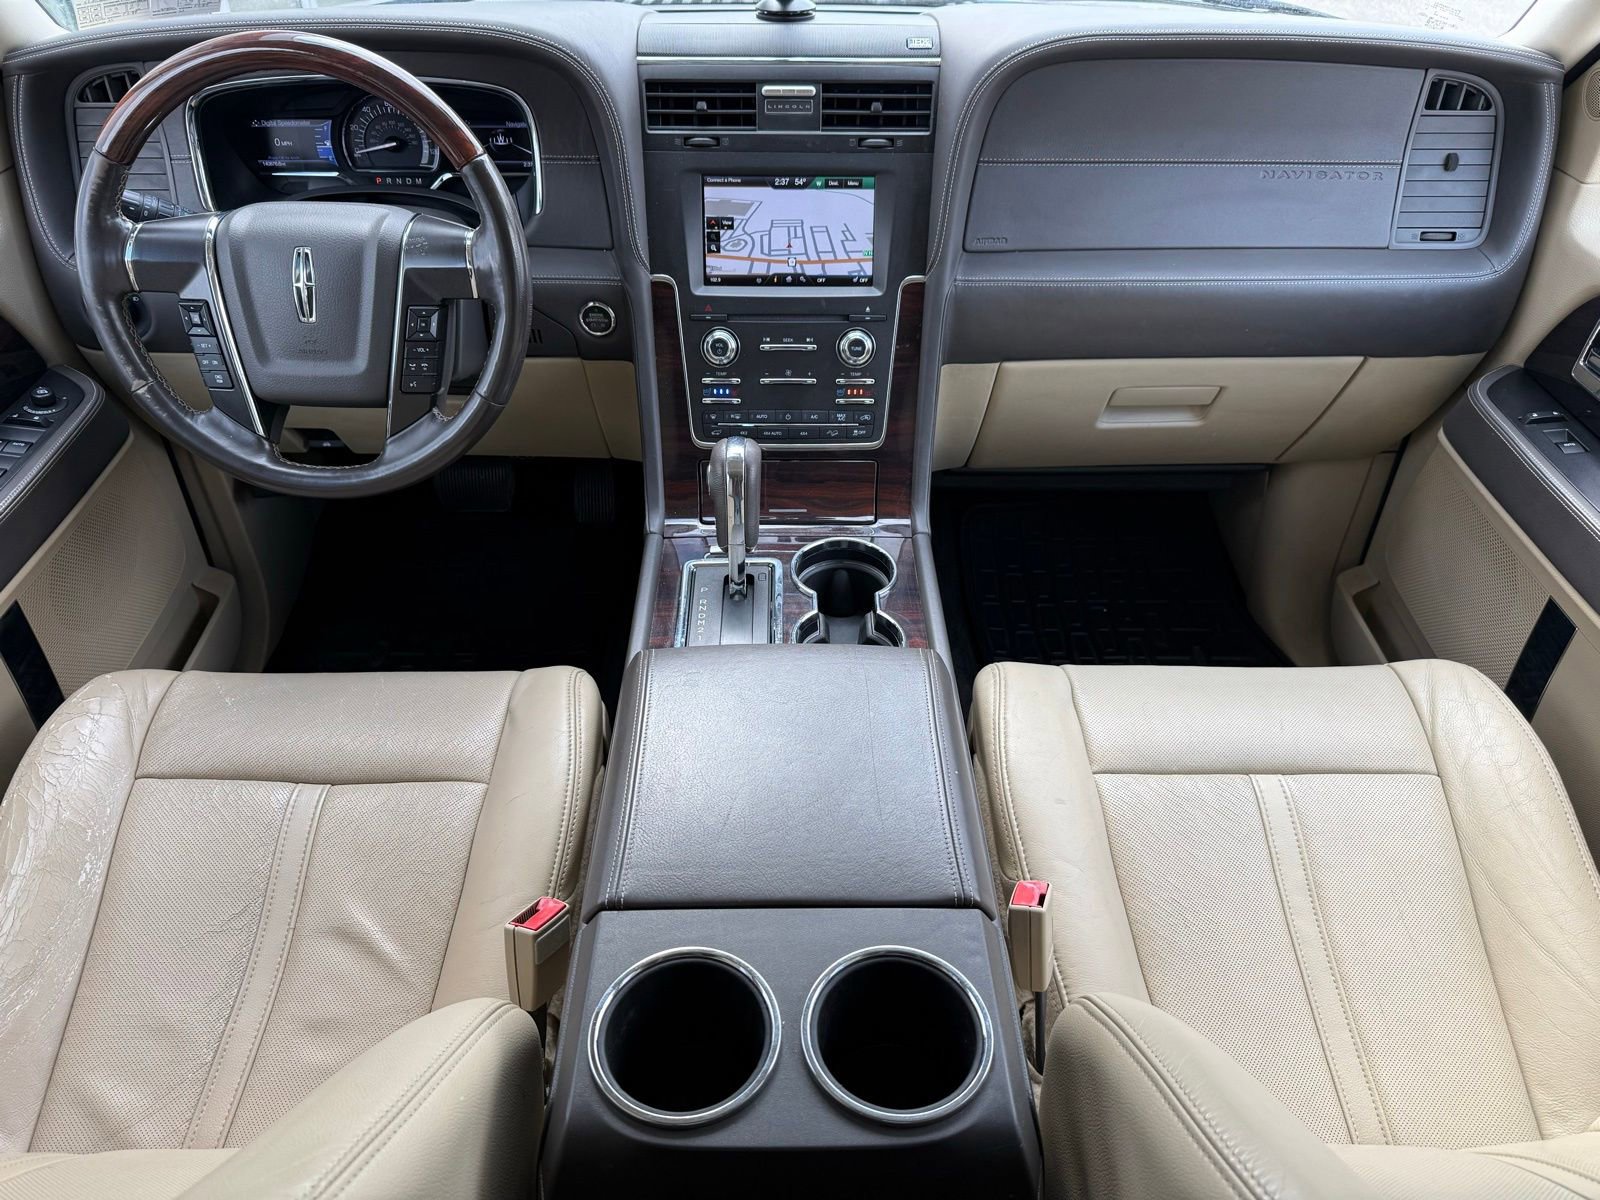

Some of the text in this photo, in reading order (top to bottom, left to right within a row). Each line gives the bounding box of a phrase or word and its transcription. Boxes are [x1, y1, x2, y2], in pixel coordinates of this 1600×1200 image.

[274, 138, 280, 147] 0
[1261, 169, 1384, 181] NAVIGATOR
[774, 178, 790, 186] 2:37
